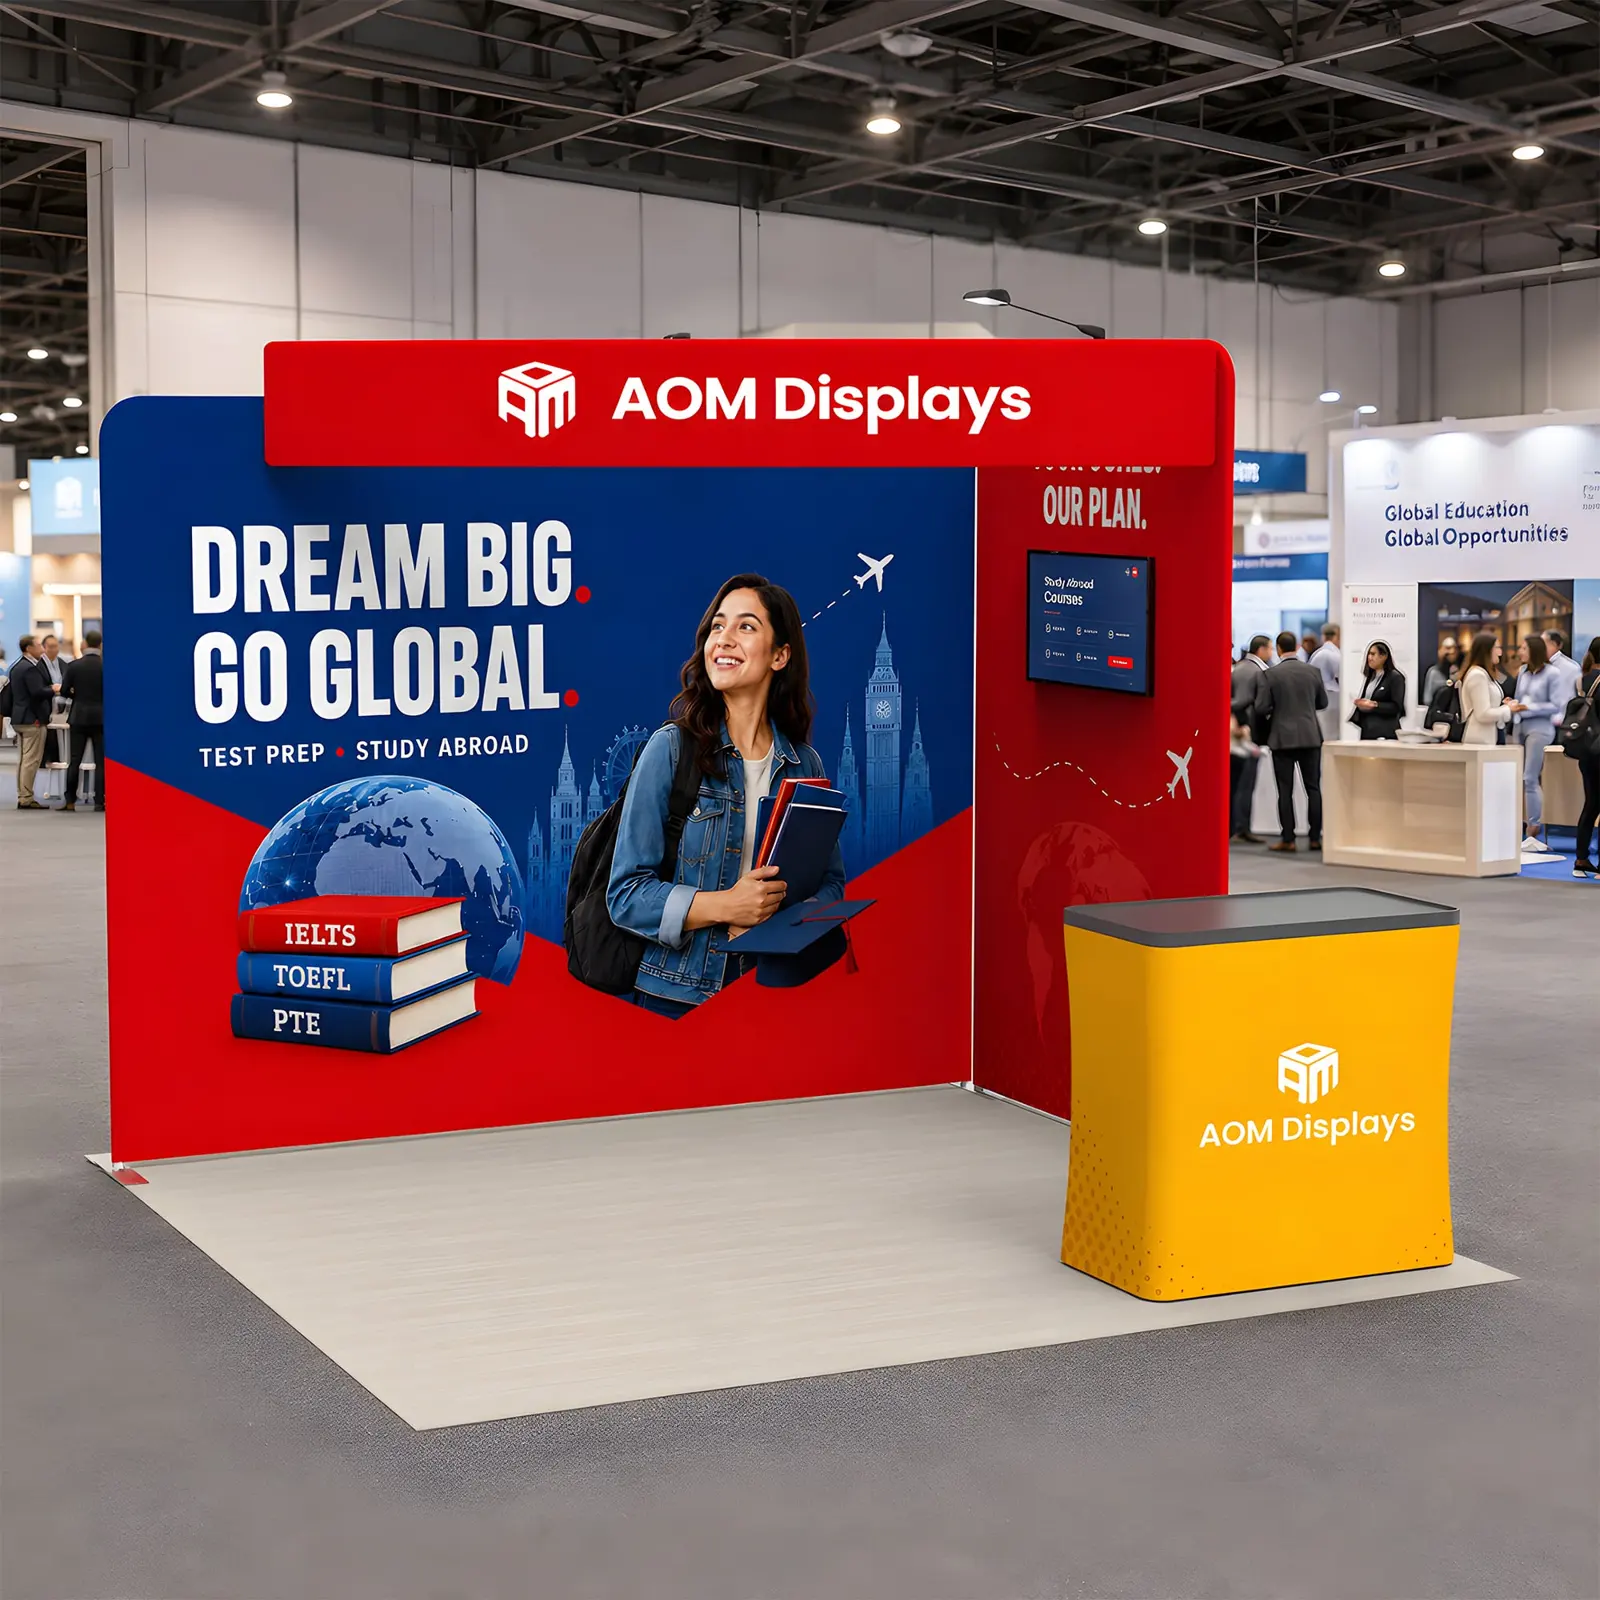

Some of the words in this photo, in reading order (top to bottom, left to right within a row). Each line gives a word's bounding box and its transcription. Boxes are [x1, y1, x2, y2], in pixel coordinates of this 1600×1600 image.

[612, 377, 757, 420] AOM
[776, 373, 1031, 435] Displays
[1043, 485, 1083, 526] OUR
[1088, 487, 1147, 530] PLAN.
[1385, 503, 1439, 522] Global
[1385, 528, 1439, 547] Global
[191, 523, 446, 614] DREAM
[467, 520, 591, 608] BIG.
[193, 631, 288, 724] GO
[309, 624, 580, 720] GLOBAL.
[199, 746, 257, 768] TEST
[266, 743, 325, 765] PREP
[356, 739, 429, 761] STUDY
[438, 734, 529, 757] ABROAD
[284, 922, 356, 947] IELTS
[273, 964, 351, 991] TOEFL
[273, 1008, 321, 1036] PTE
[1199, 1119, 1273, 1148] AOM
[1283, 1110, 1416, 1146] Displays
